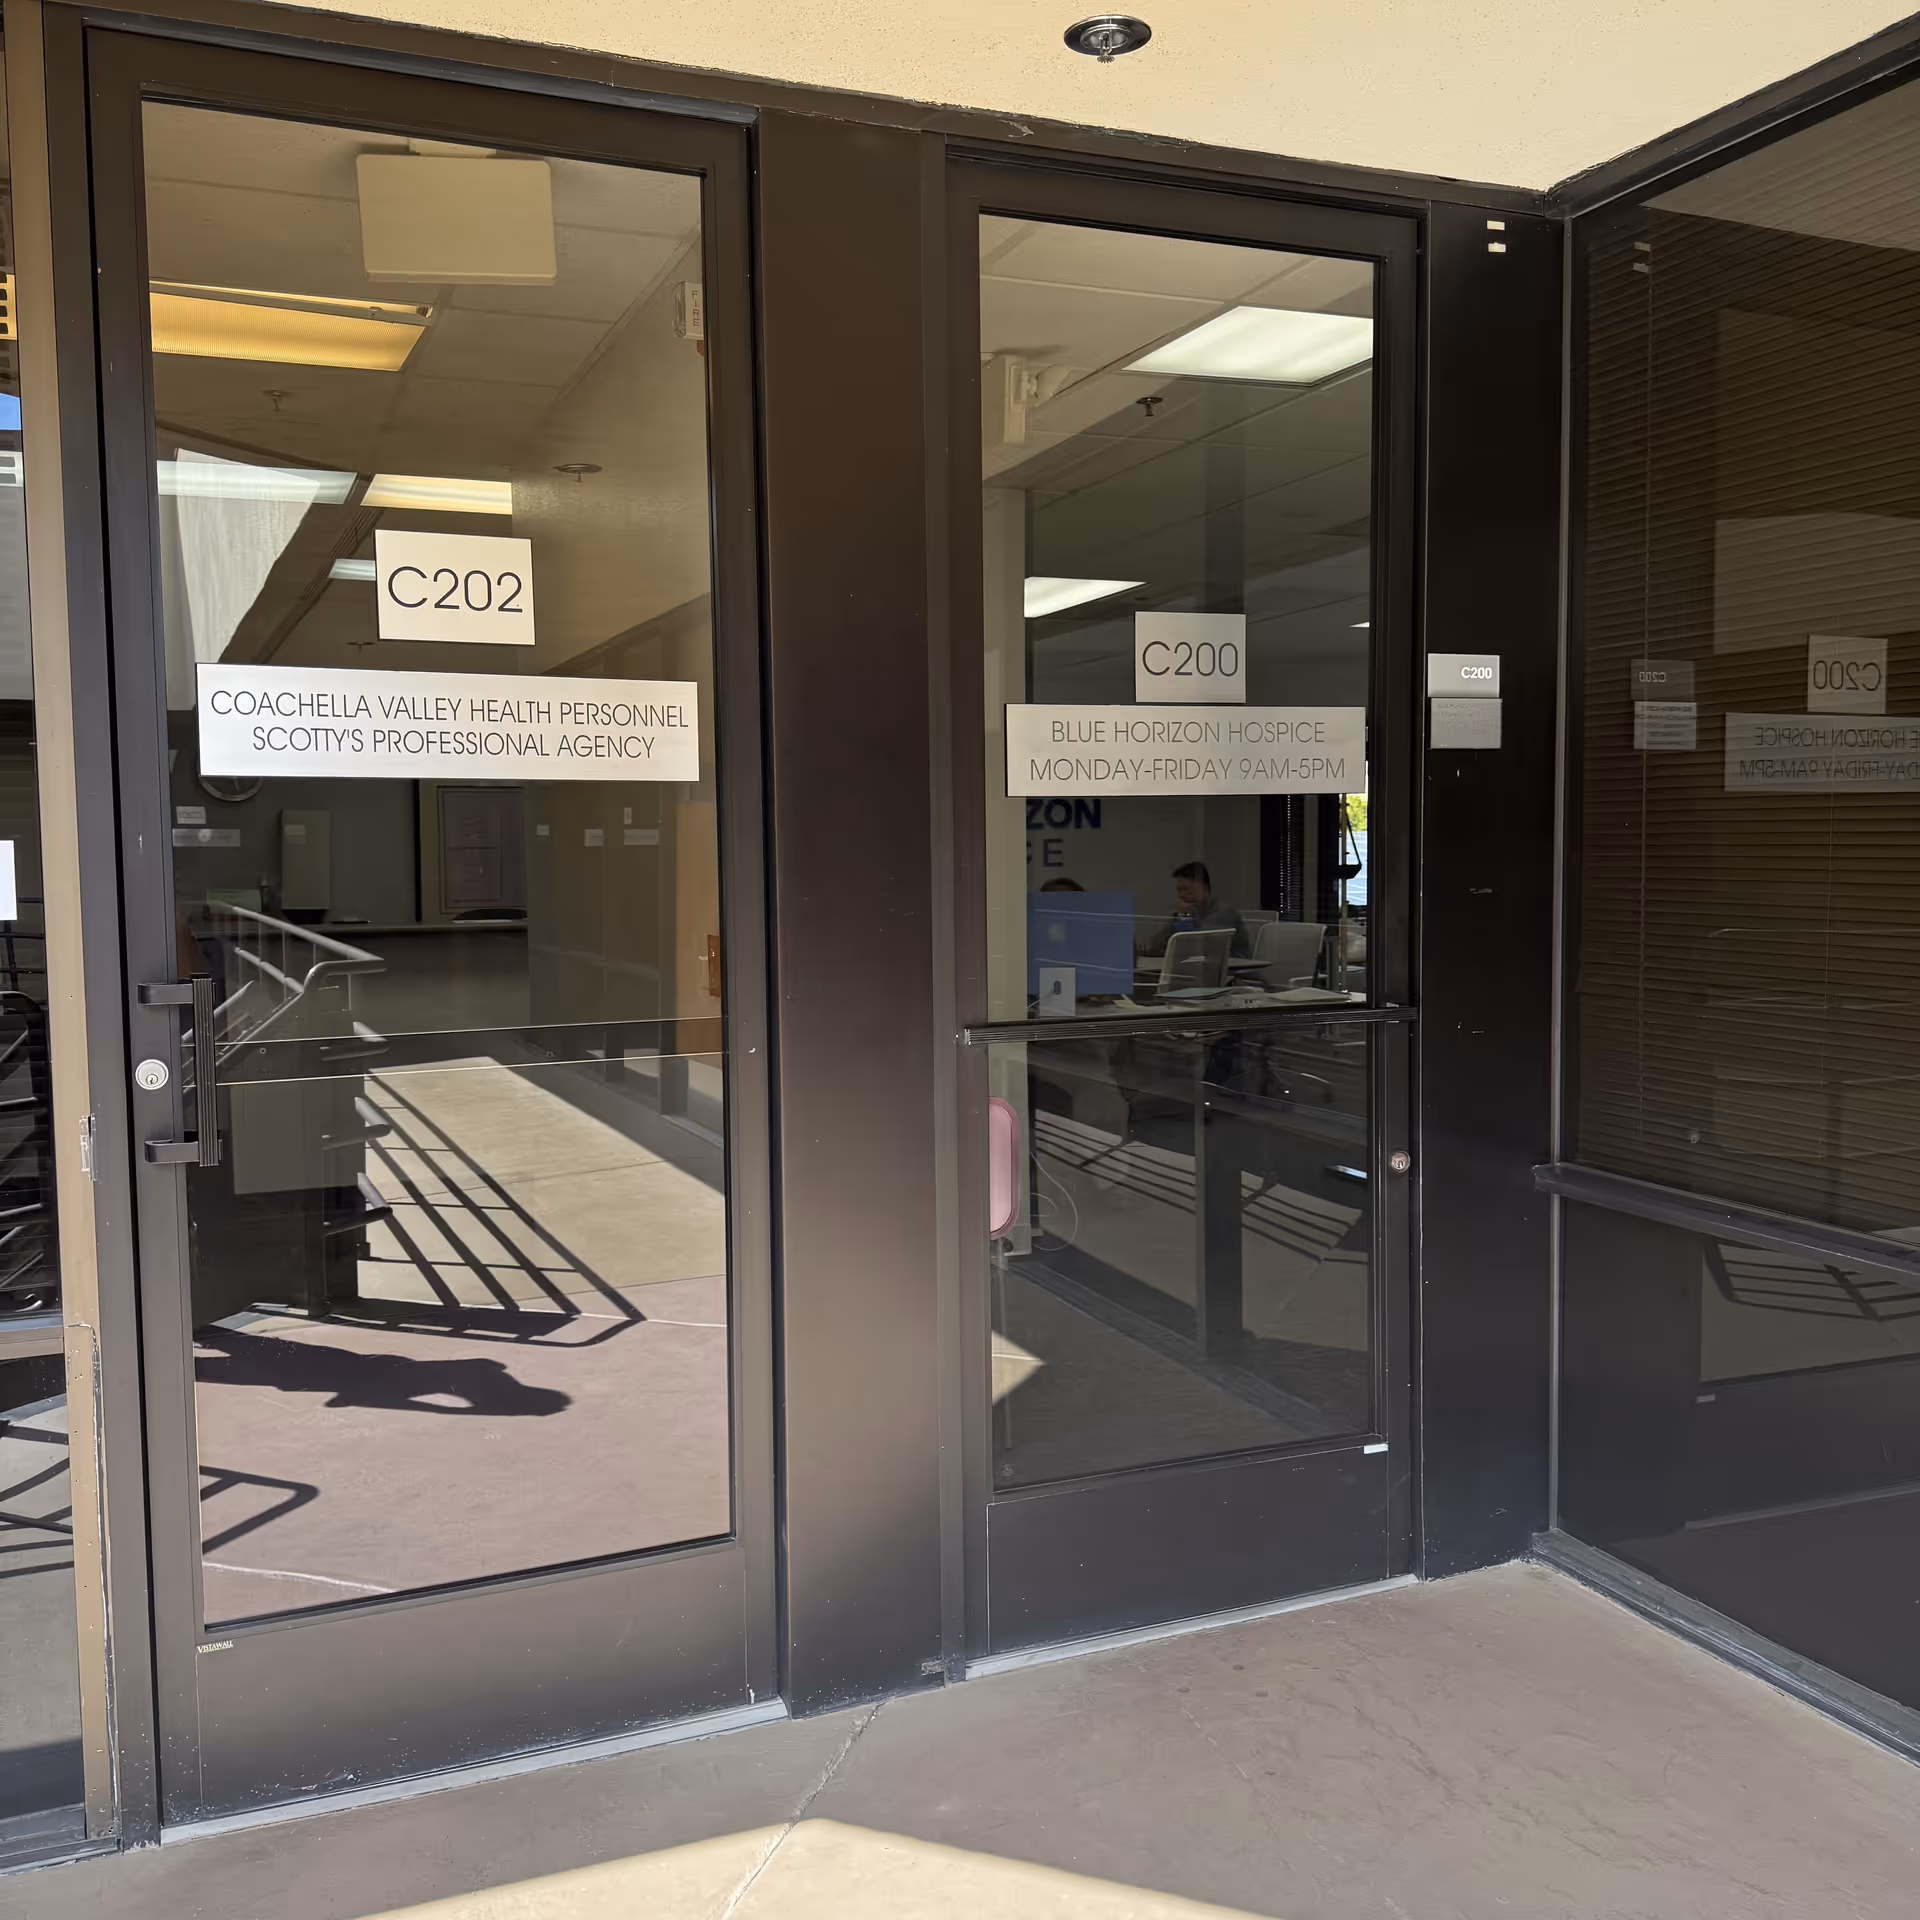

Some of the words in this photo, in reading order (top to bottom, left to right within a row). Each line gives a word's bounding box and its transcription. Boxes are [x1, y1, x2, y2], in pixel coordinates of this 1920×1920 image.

[691, 290, 701, 327] FIRE
[387, 565, 524, 614] C202
[1142, 640, 1239, 677] C200
[1460, 666, 1493, 679] C200
[211, 690, 373, 719] COACHELLA
[378, 695, 462, 721] VALLEY
[470, 699, 551, 724] HEALTH
[560, 702, 689, 728] PERSONNEL
[253, 726, 364, 752] SCOTTY'S
[373, 729, 550, 757] PROFESSIONAL
[557, 734, 655, 759] AGENCY
[1052, 720, 1106, 743] BLUE
[1114, 721, 1220, 743] HORIZON
[1228, 721, 1325, 743] HOSPICE
[1030, 758, 1233, 781] MONDAY-FRIDAY
[1239, 757, 1345, 780] 9AM-5PM
